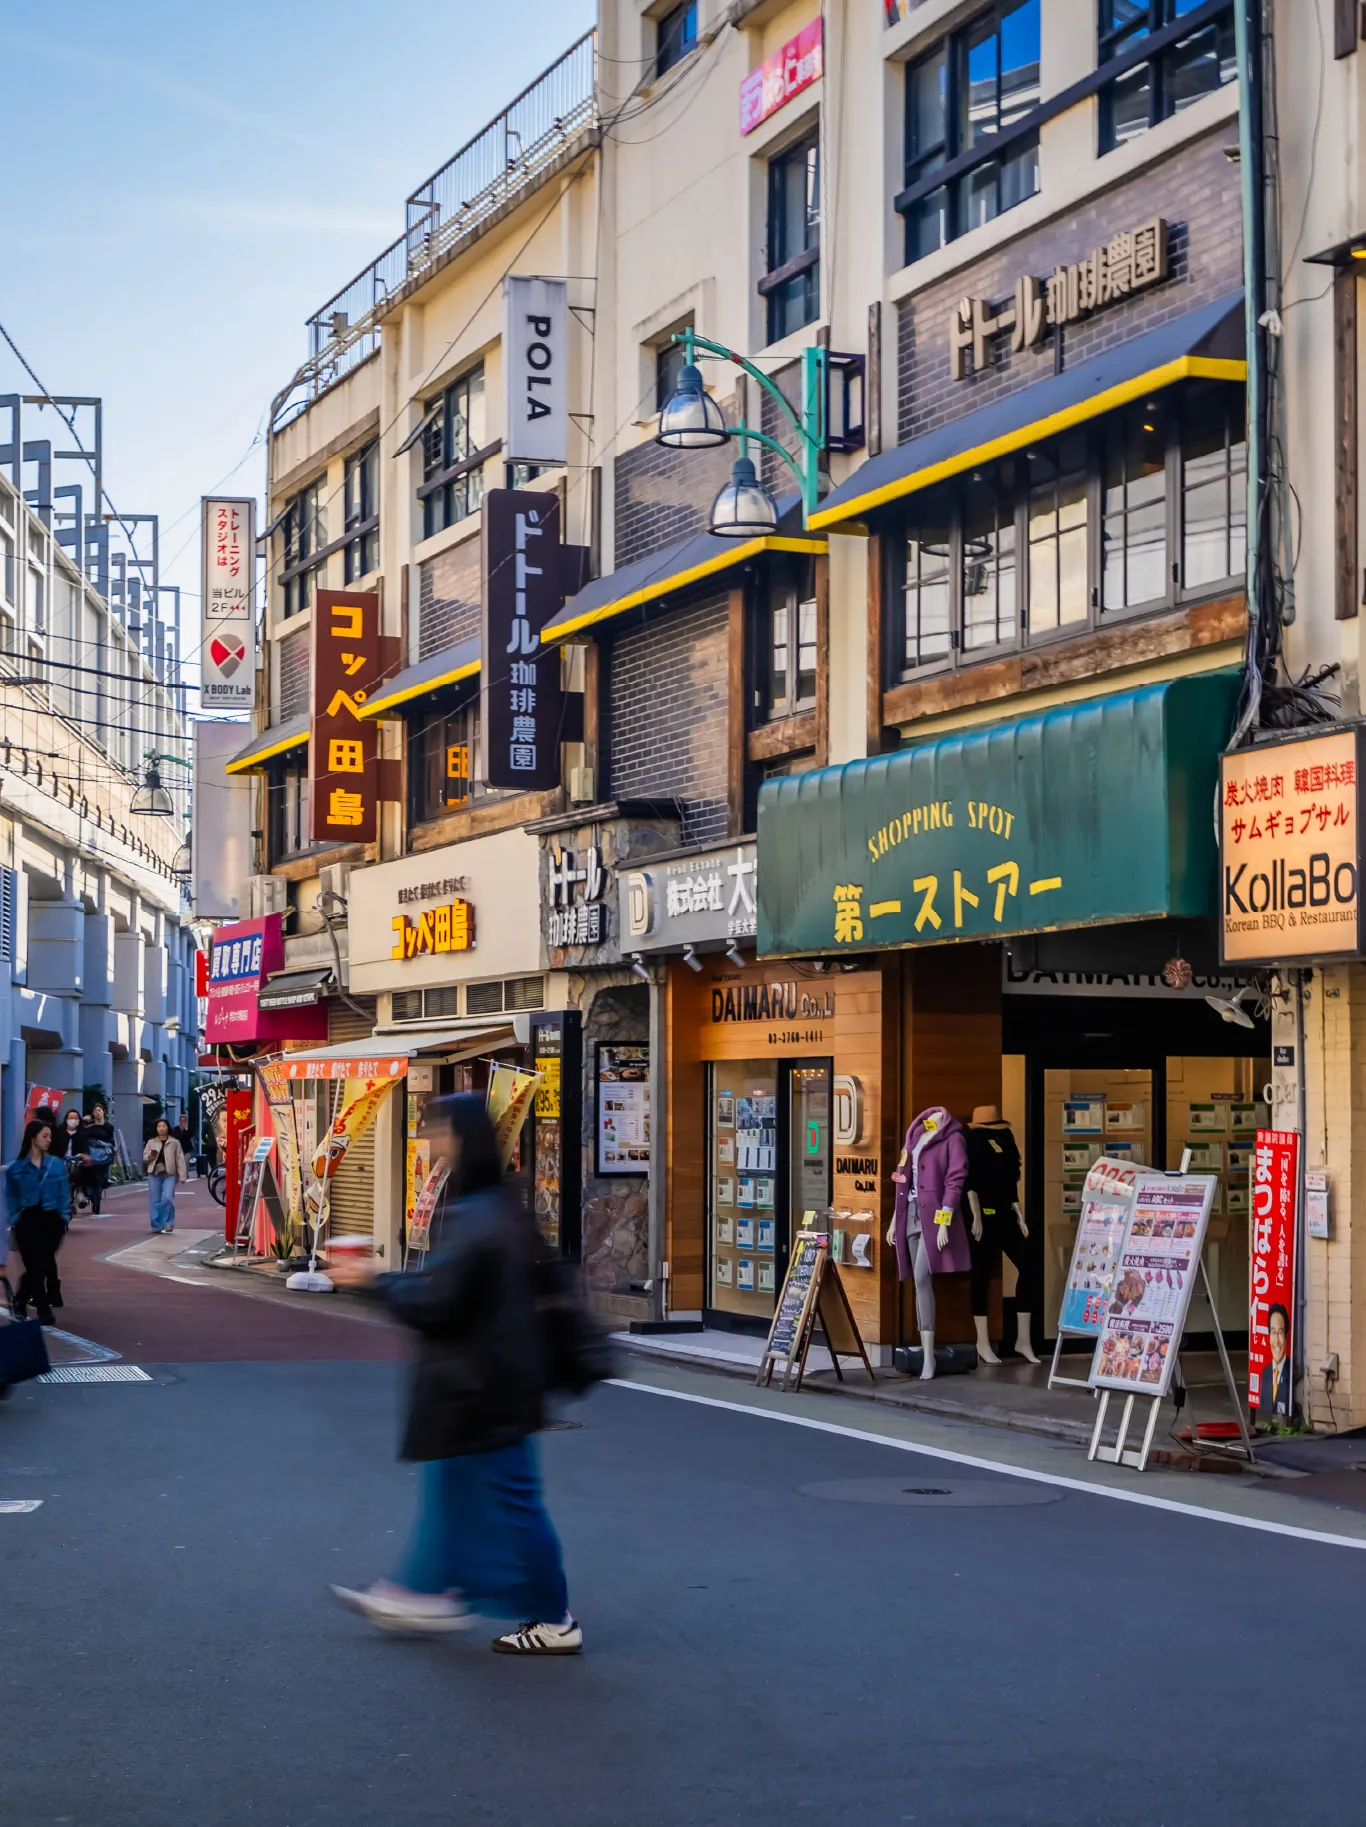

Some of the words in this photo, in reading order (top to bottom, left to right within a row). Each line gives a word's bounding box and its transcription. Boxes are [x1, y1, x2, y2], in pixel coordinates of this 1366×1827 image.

[525, 314, 553, 422] POLA
[217, 508, 228, 567] スタジオは
[229, 508, 240, 577] トレーニング
[211, 602, 228, 613] 2F
[212, 588, 244, 599] 当ビル
[506, 509, 543, 771] ドトール珈琲農園
[204, 684, 210, 694] X
[211, 684, 234, 695] BODY
[236, 684, 252, 695] Lab
[326, 605, 367, 825] コッペ田島
[1224, 772, 1284, 807] 炭火焼肉
[1294, 760, 1357, 796] 韓国料理
[867, 800, 953, 863] SHOPPING
[967, 800, 1015, 840] SPOT
[1231, 802, 1350, 844] サムギョプサル
[549, 846, 601, 907] ドトール
[666, 873, 724, 917] 株式会社
[727, 847, 758, 916] 大
[832, 860, 1062, 943] 第一ストアー
[1225, 852, 1358, 915] KollaBo
[392, 898, 472, 960] コッペ田島
[1225, 917, 1259, 933] Korean
[1262, 913, 1285, 931] BBQ
[1288, 912, 1297, 927] &
[1300, 908, 1357, 926] Restaurant
[211, 937, 262, 979] 買取専門店
[712, 982, 797, 1022] DAIMARU
[836, 1158, 878, 1176] DAIMARU
[1250, 1145, 1274, 1335] まつばら仁
